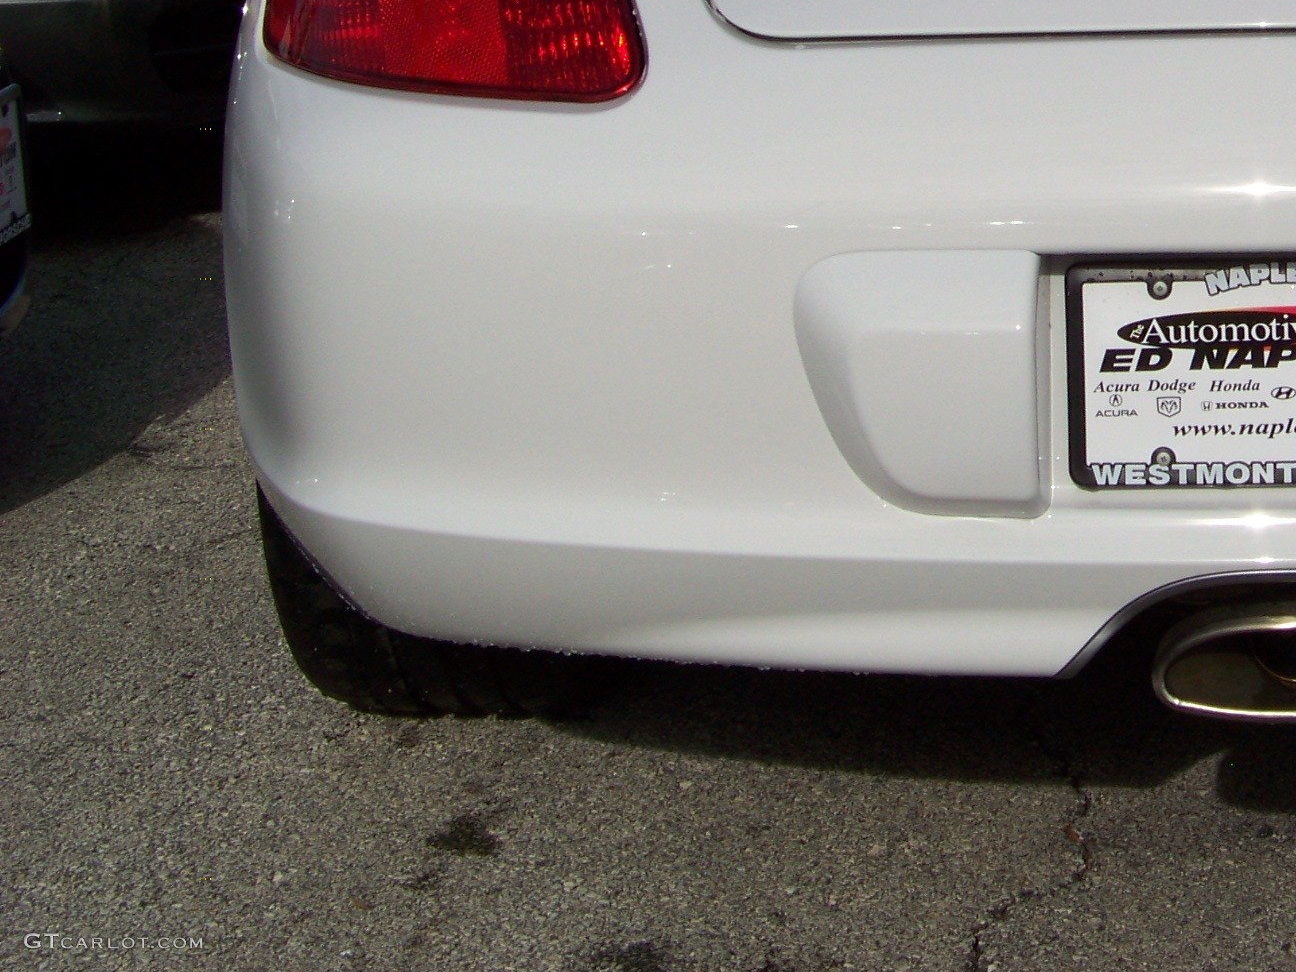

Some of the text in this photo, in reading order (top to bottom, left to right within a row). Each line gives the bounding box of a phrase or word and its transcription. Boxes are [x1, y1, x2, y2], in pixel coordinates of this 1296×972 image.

[1129, 324, 1145, 340] The
[1100, 347, 1173, 373] ED
[1093, 381, 1140, 393] Acura
[1147, 379, 1196, 394] Dodge
[1209, 380, 1261, 392] Honda
[1215, 401, 1269, 410] HONDA
[1095, 409, 1138, 417] ACURA
